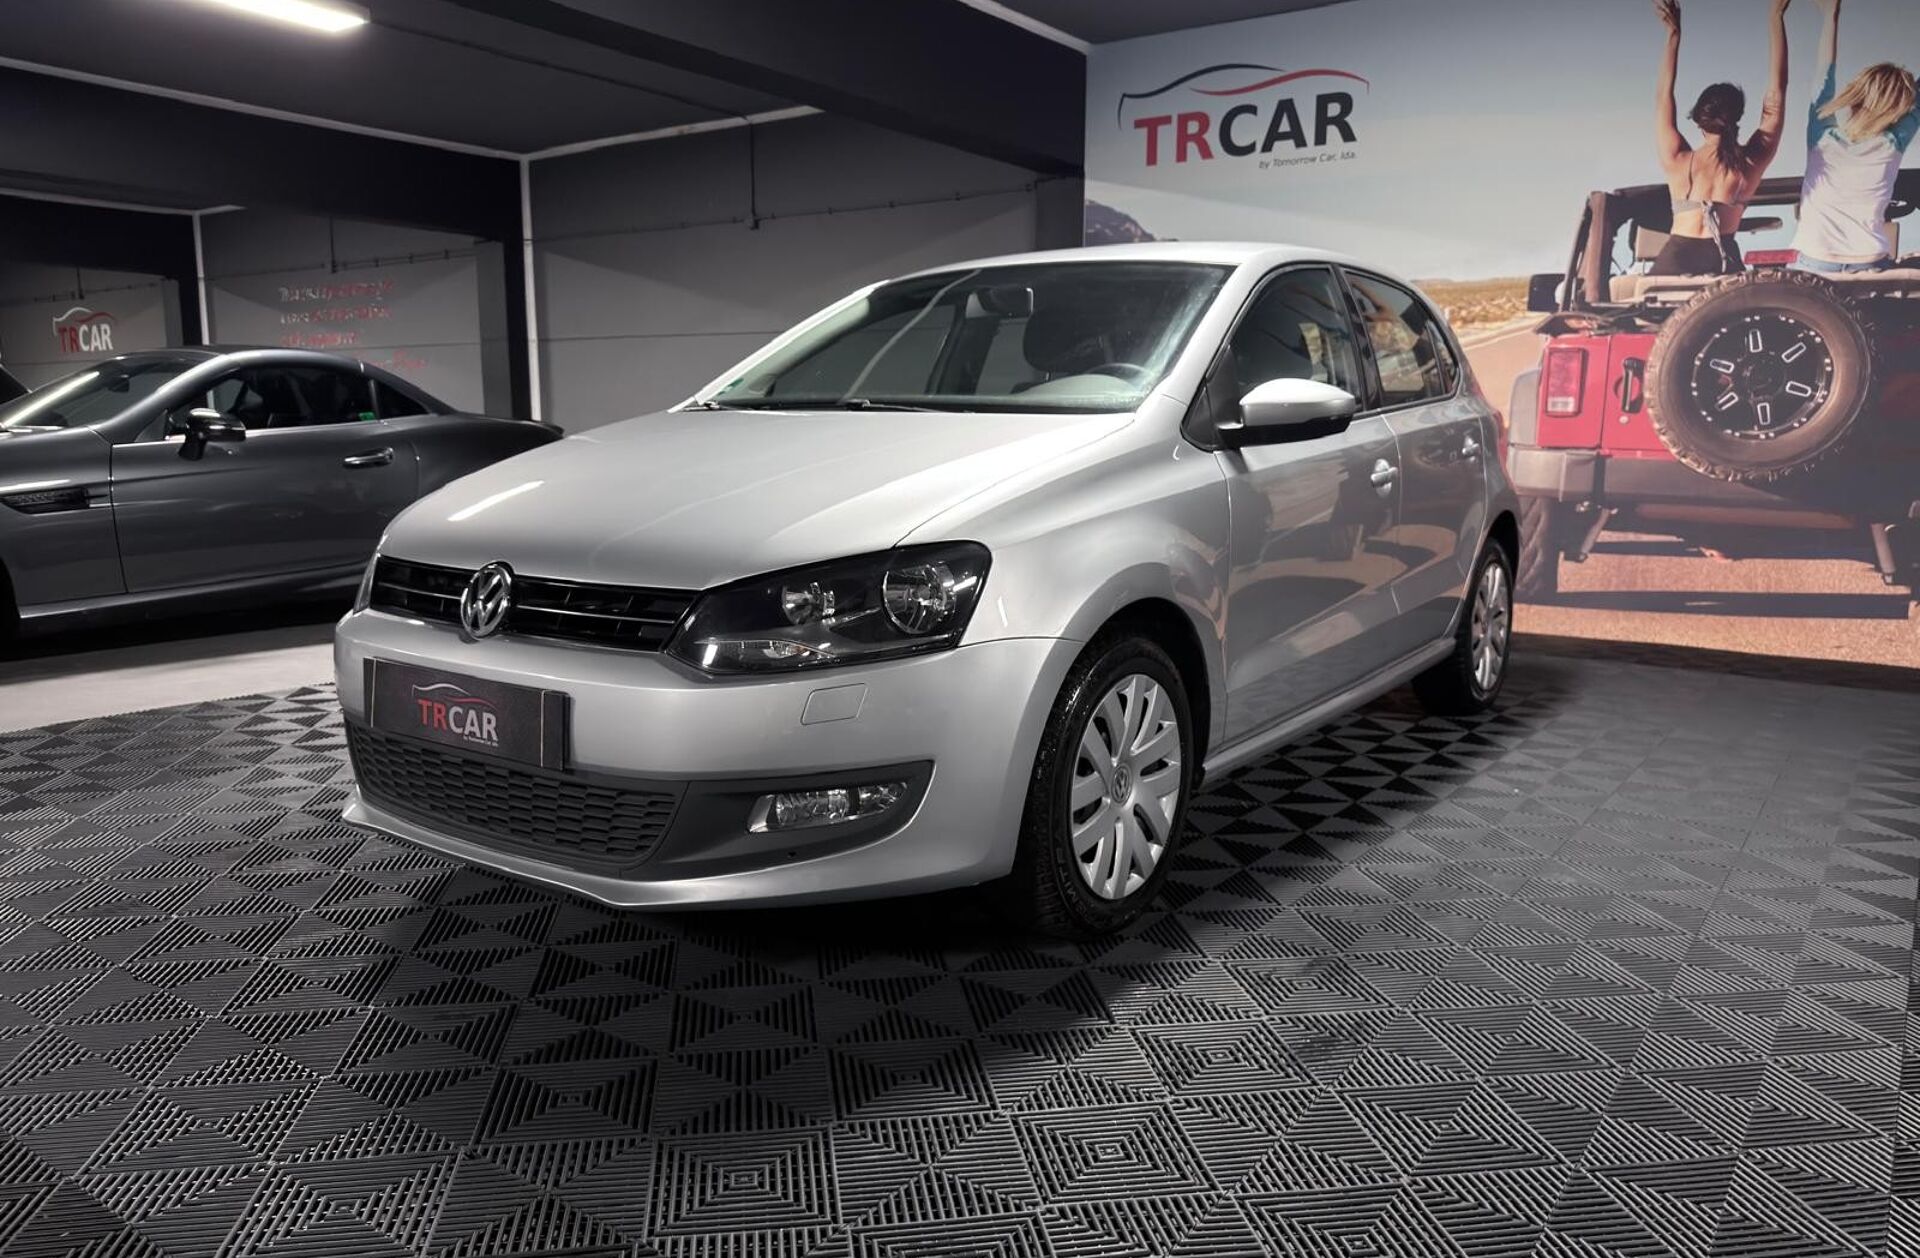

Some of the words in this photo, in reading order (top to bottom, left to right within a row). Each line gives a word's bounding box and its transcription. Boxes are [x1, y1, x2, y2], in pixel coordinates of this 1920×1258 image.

[1134, 92, 1356, 166] TRCAR
[1259, 160, 1270, 169] by
[1273, 156, 1317, 167] Tomorrow
[58, 323, 113, 352] TRCAR
[418, 699, 498, 741] TRCAR
